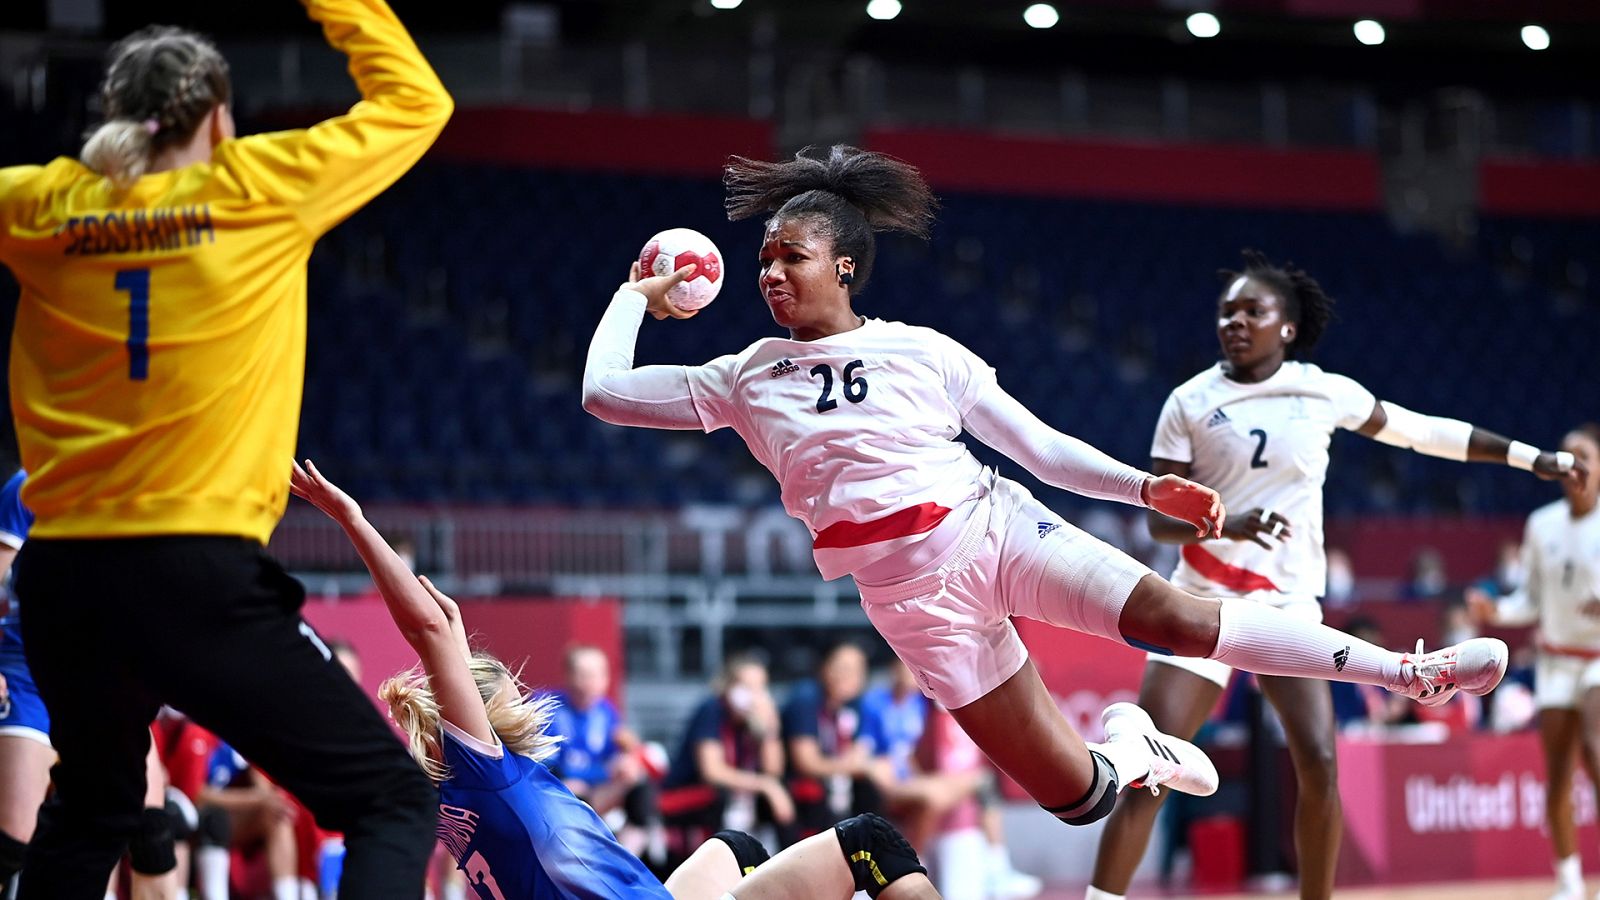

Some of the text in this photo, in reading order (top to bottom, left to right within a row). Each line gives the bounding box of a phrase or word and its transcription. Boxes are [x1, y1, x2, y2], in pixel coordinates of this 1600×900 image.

[114, 268, 150, 380] 1
[771, 364, 800, 378] adidas
[809, 359, 868, 414] 26
[1249, 428, 1269, 470] 2
[298, 620, 333, 662] 1
[1404, 772, 1517, 834] United
